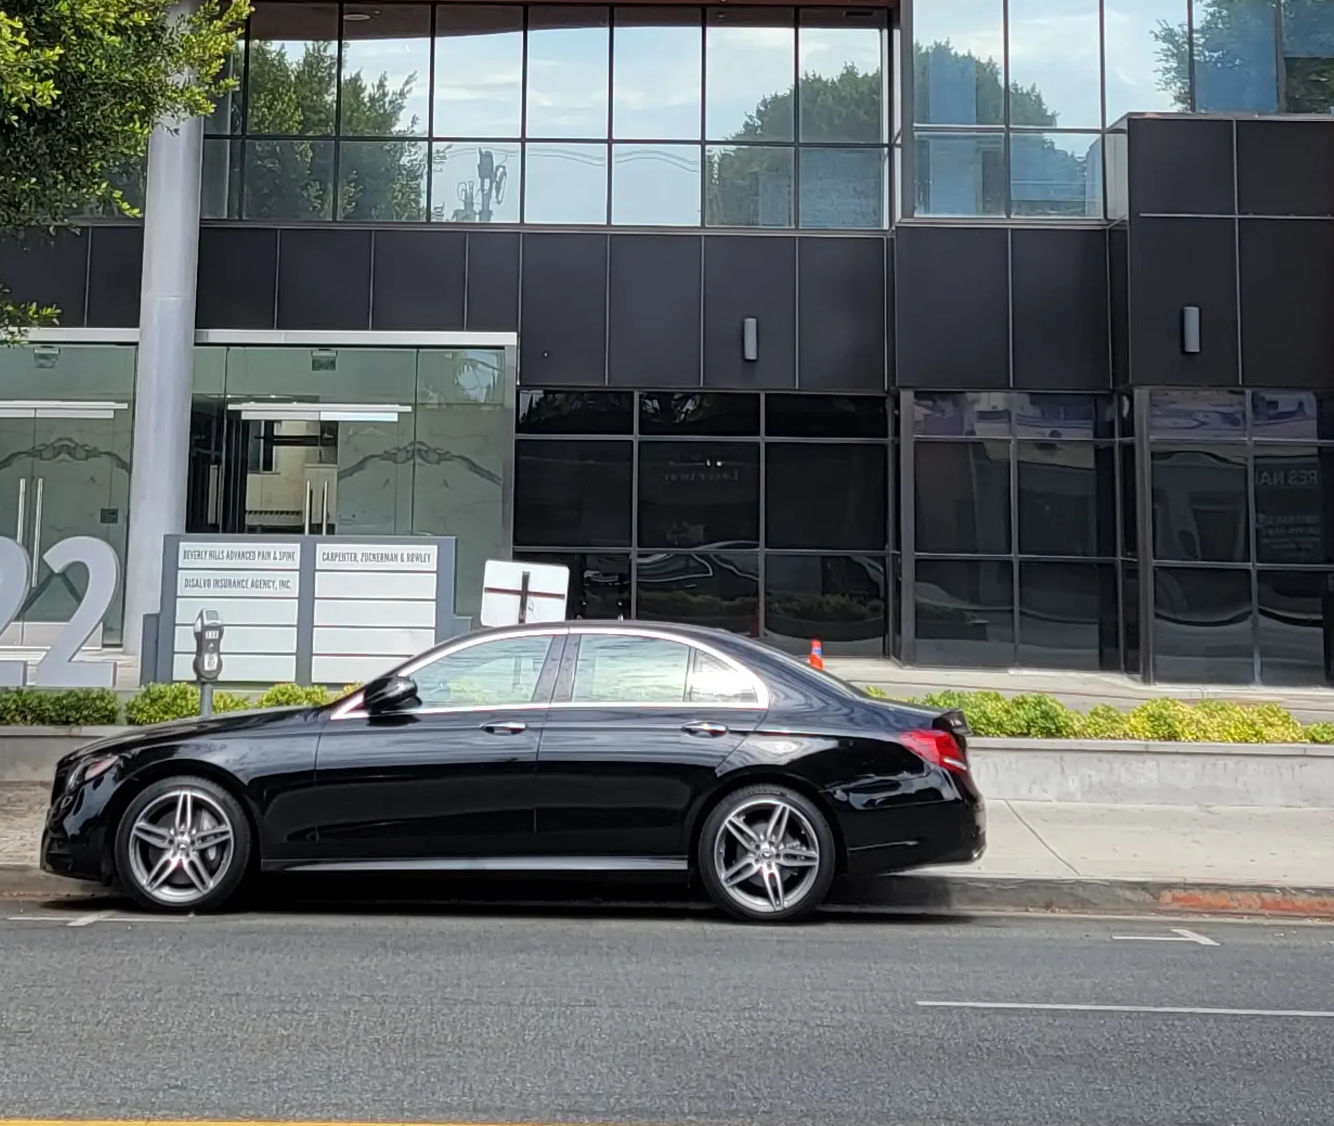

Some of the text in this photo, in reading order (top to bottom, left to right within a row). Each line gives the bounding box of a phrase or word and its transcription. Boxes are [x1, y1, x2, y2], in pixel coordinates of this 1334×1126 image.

[183, 549, 208, 560] BEVERLY
[208, 549, 225, 561] HILLS
[226, 550, 256, 561] ADVANCED
[257, 551, 271, 562] PAIN
[278, 551, 296, 562] SPINE
[360, 551, 399, 563] ZUCKERMAN
[406, 552, 432, 564] ROWLEY
[184, 577, 292, 591] DISALVO INSURANCE AGENCY, INC.
